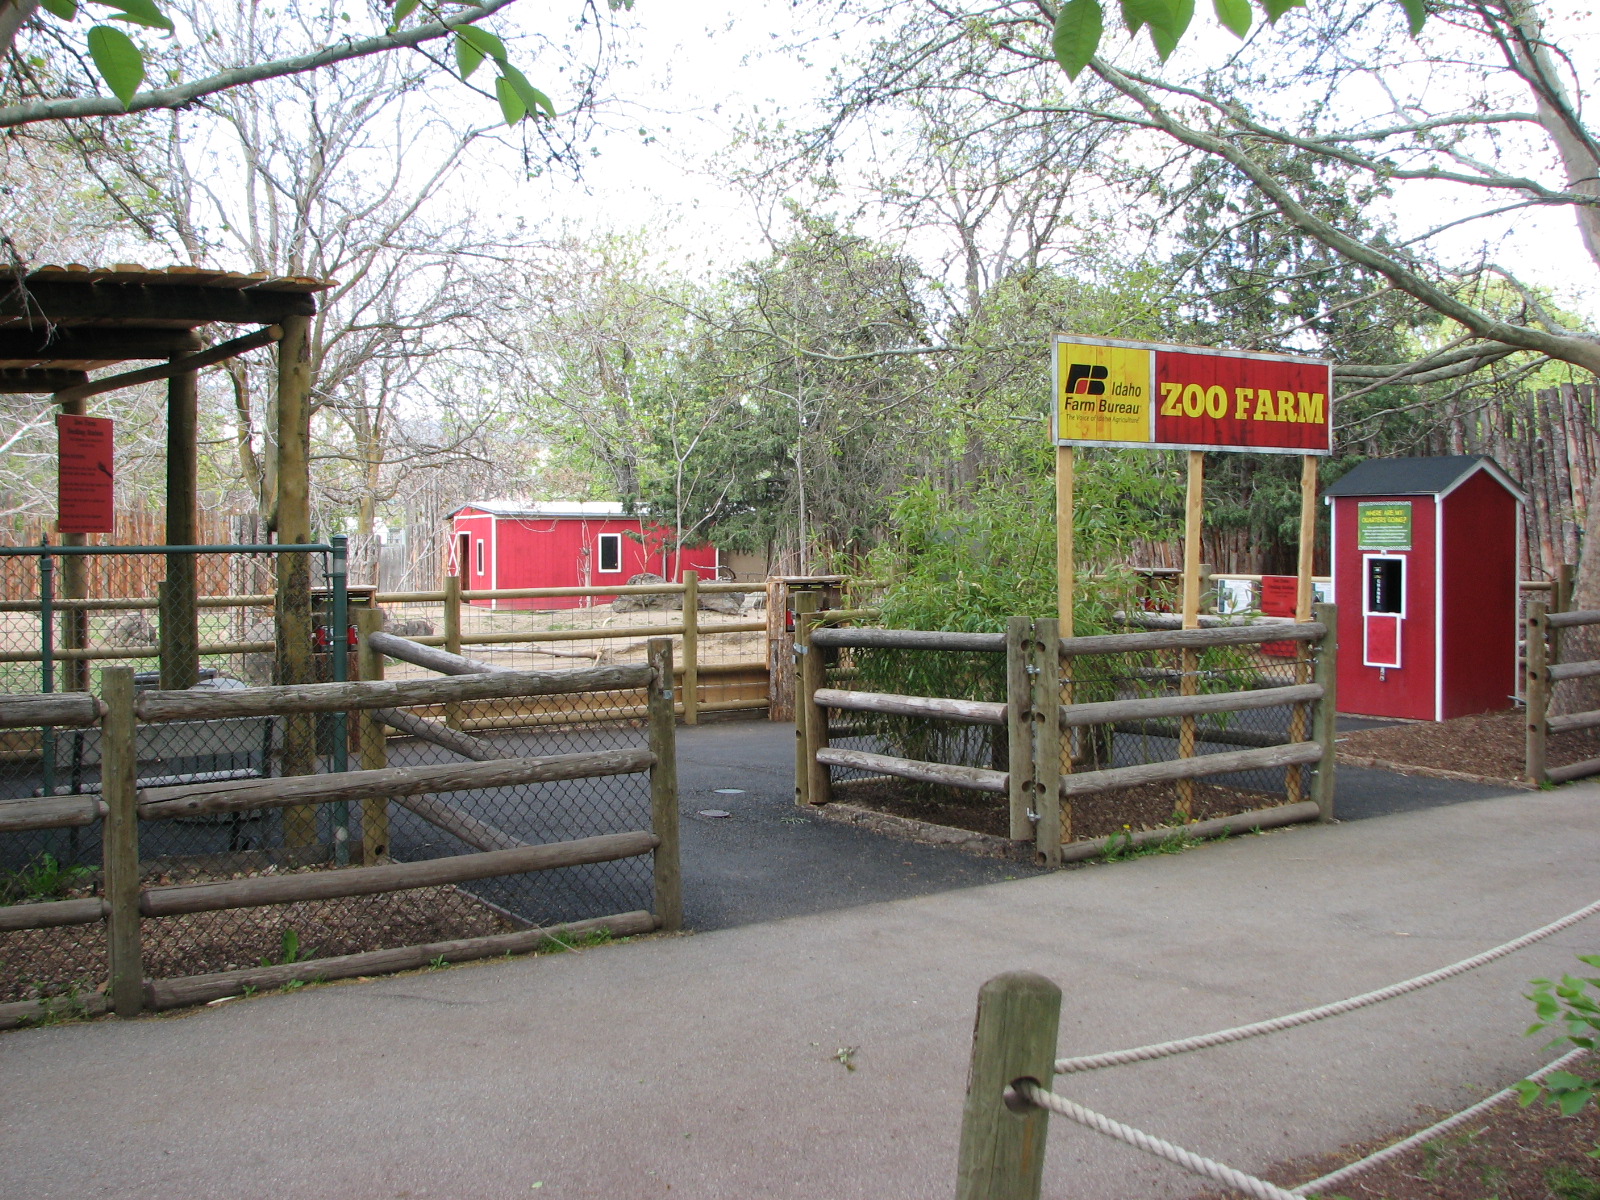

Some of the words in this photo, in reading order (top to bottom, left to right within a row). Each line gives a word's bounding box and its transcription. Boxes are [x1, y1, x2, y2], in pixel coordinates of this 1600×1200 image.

[1112, 382, 1141, 397] Idaho
[1065, 396, 1095, 411] Farm
[1099, 399, 1140, 414] Bureau
[1160, 382, 1228, 419] ZOO
[1235, 387, 1324, 424] FARM
